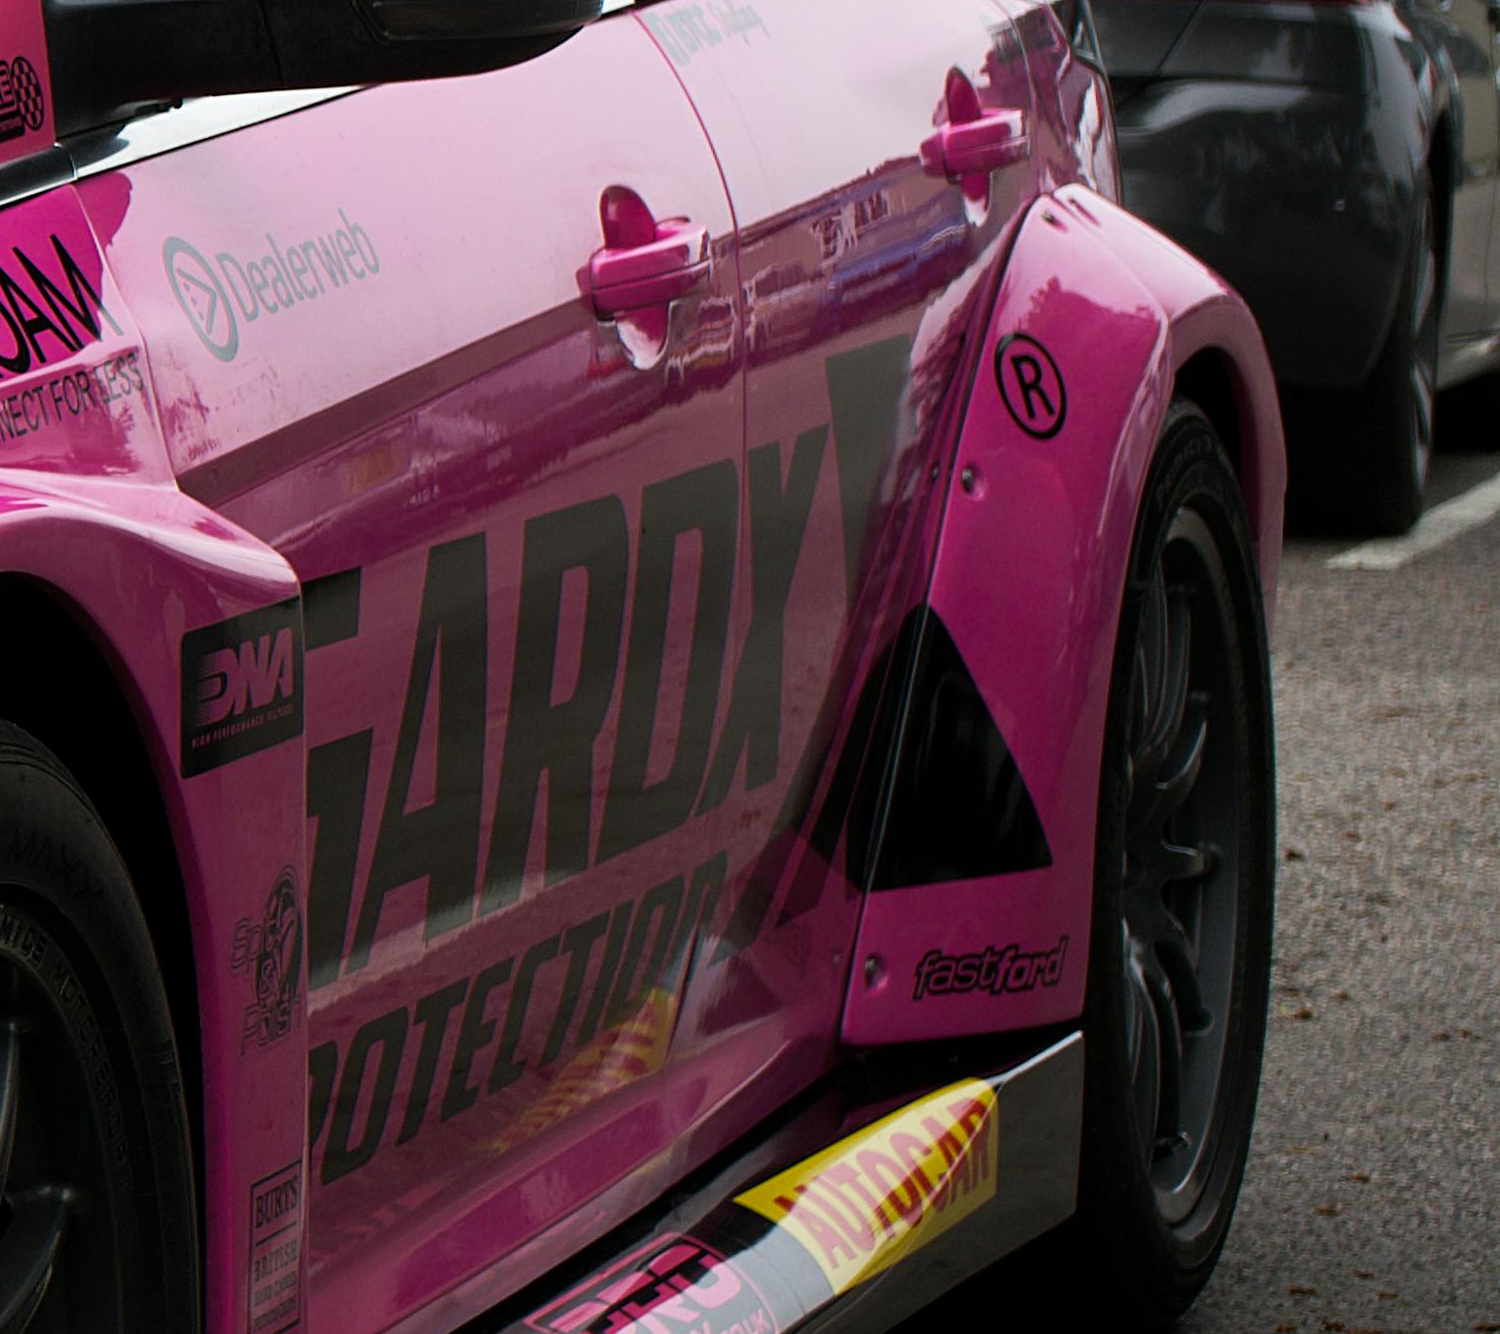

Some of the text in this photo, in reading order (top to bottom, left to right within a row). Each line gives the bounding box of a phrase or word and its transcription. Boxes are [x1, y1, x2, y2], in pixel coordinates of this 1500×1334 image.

[217, 207, 381, 323] Dealerweb
[51, 371, 94, 422] FOR
[90, 352, 145, 407] LESS
[196, 627, 294, 727] DNA
[308, 852, 728, 1186] OTECTION
[255, 1175, 298, 1229] BURTS
[774, 1096, 990, 1270] AUTOCAR
